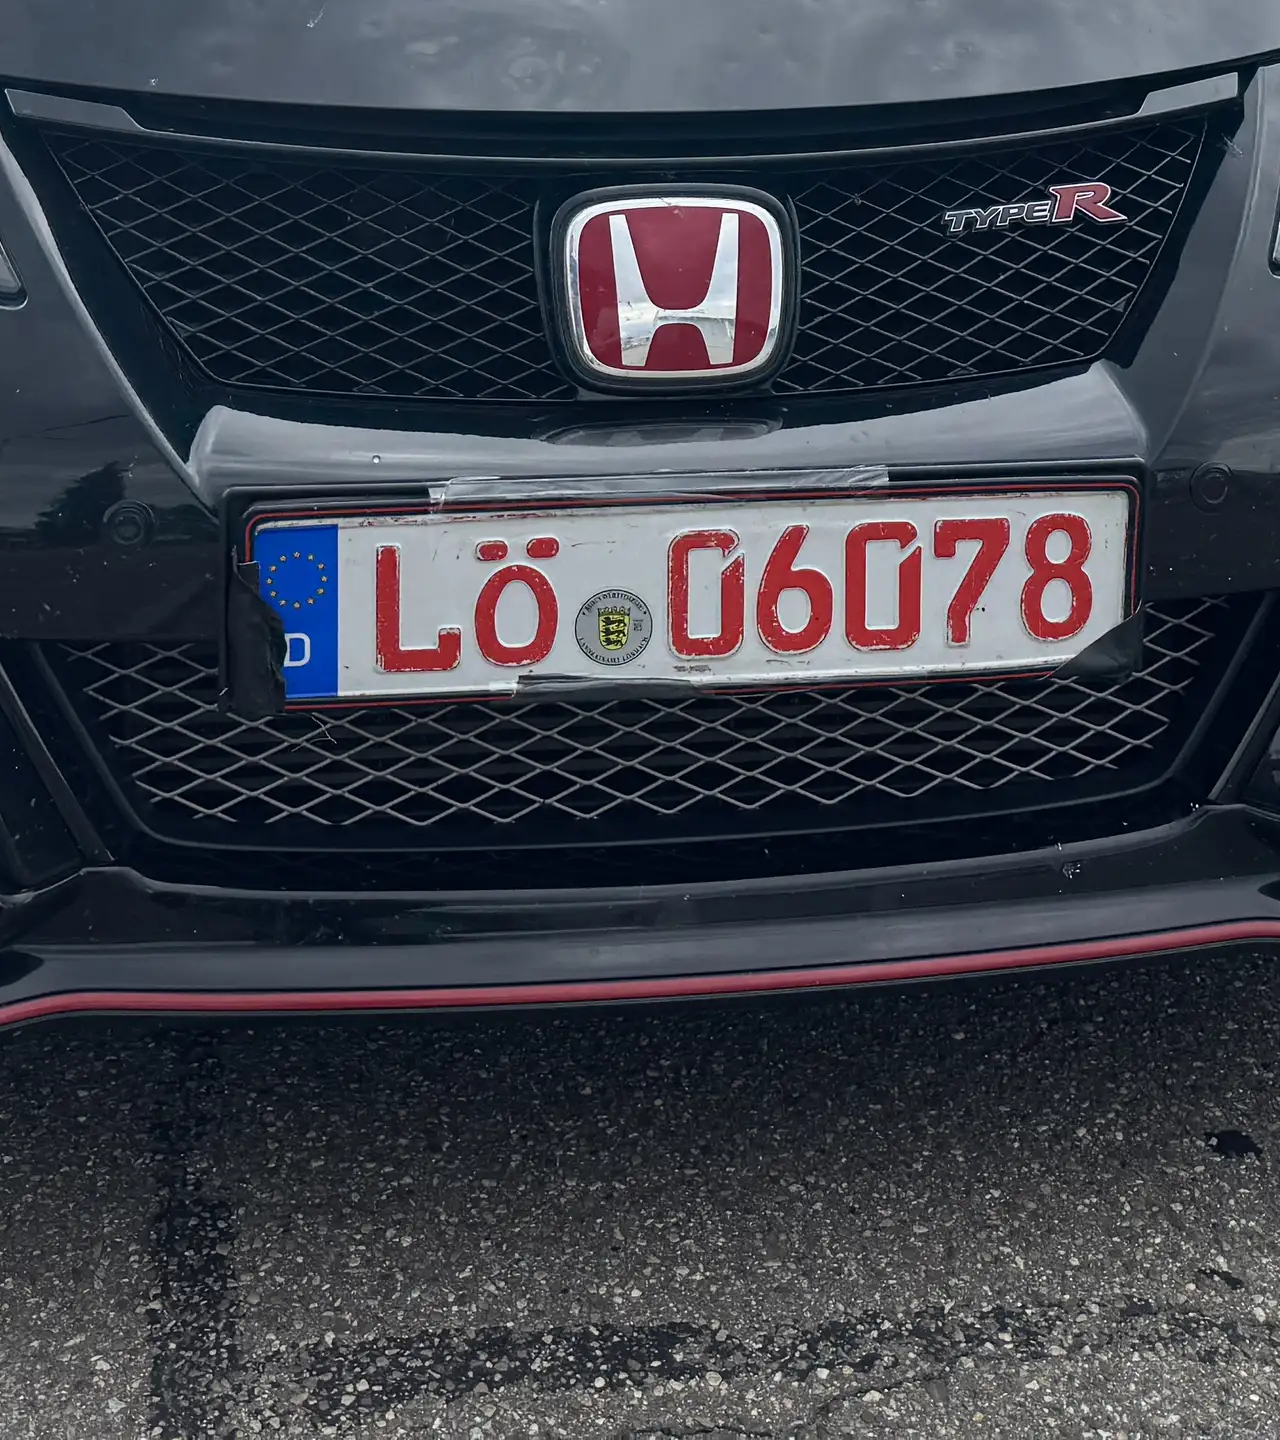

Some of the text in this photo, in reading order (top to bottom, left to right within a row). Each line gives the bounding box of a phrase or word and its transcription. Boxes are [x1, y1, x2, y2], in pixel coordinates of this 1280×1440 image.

[375, 512, 1093, 673] LÖ 06078
[284, 633, 311, 667] D
